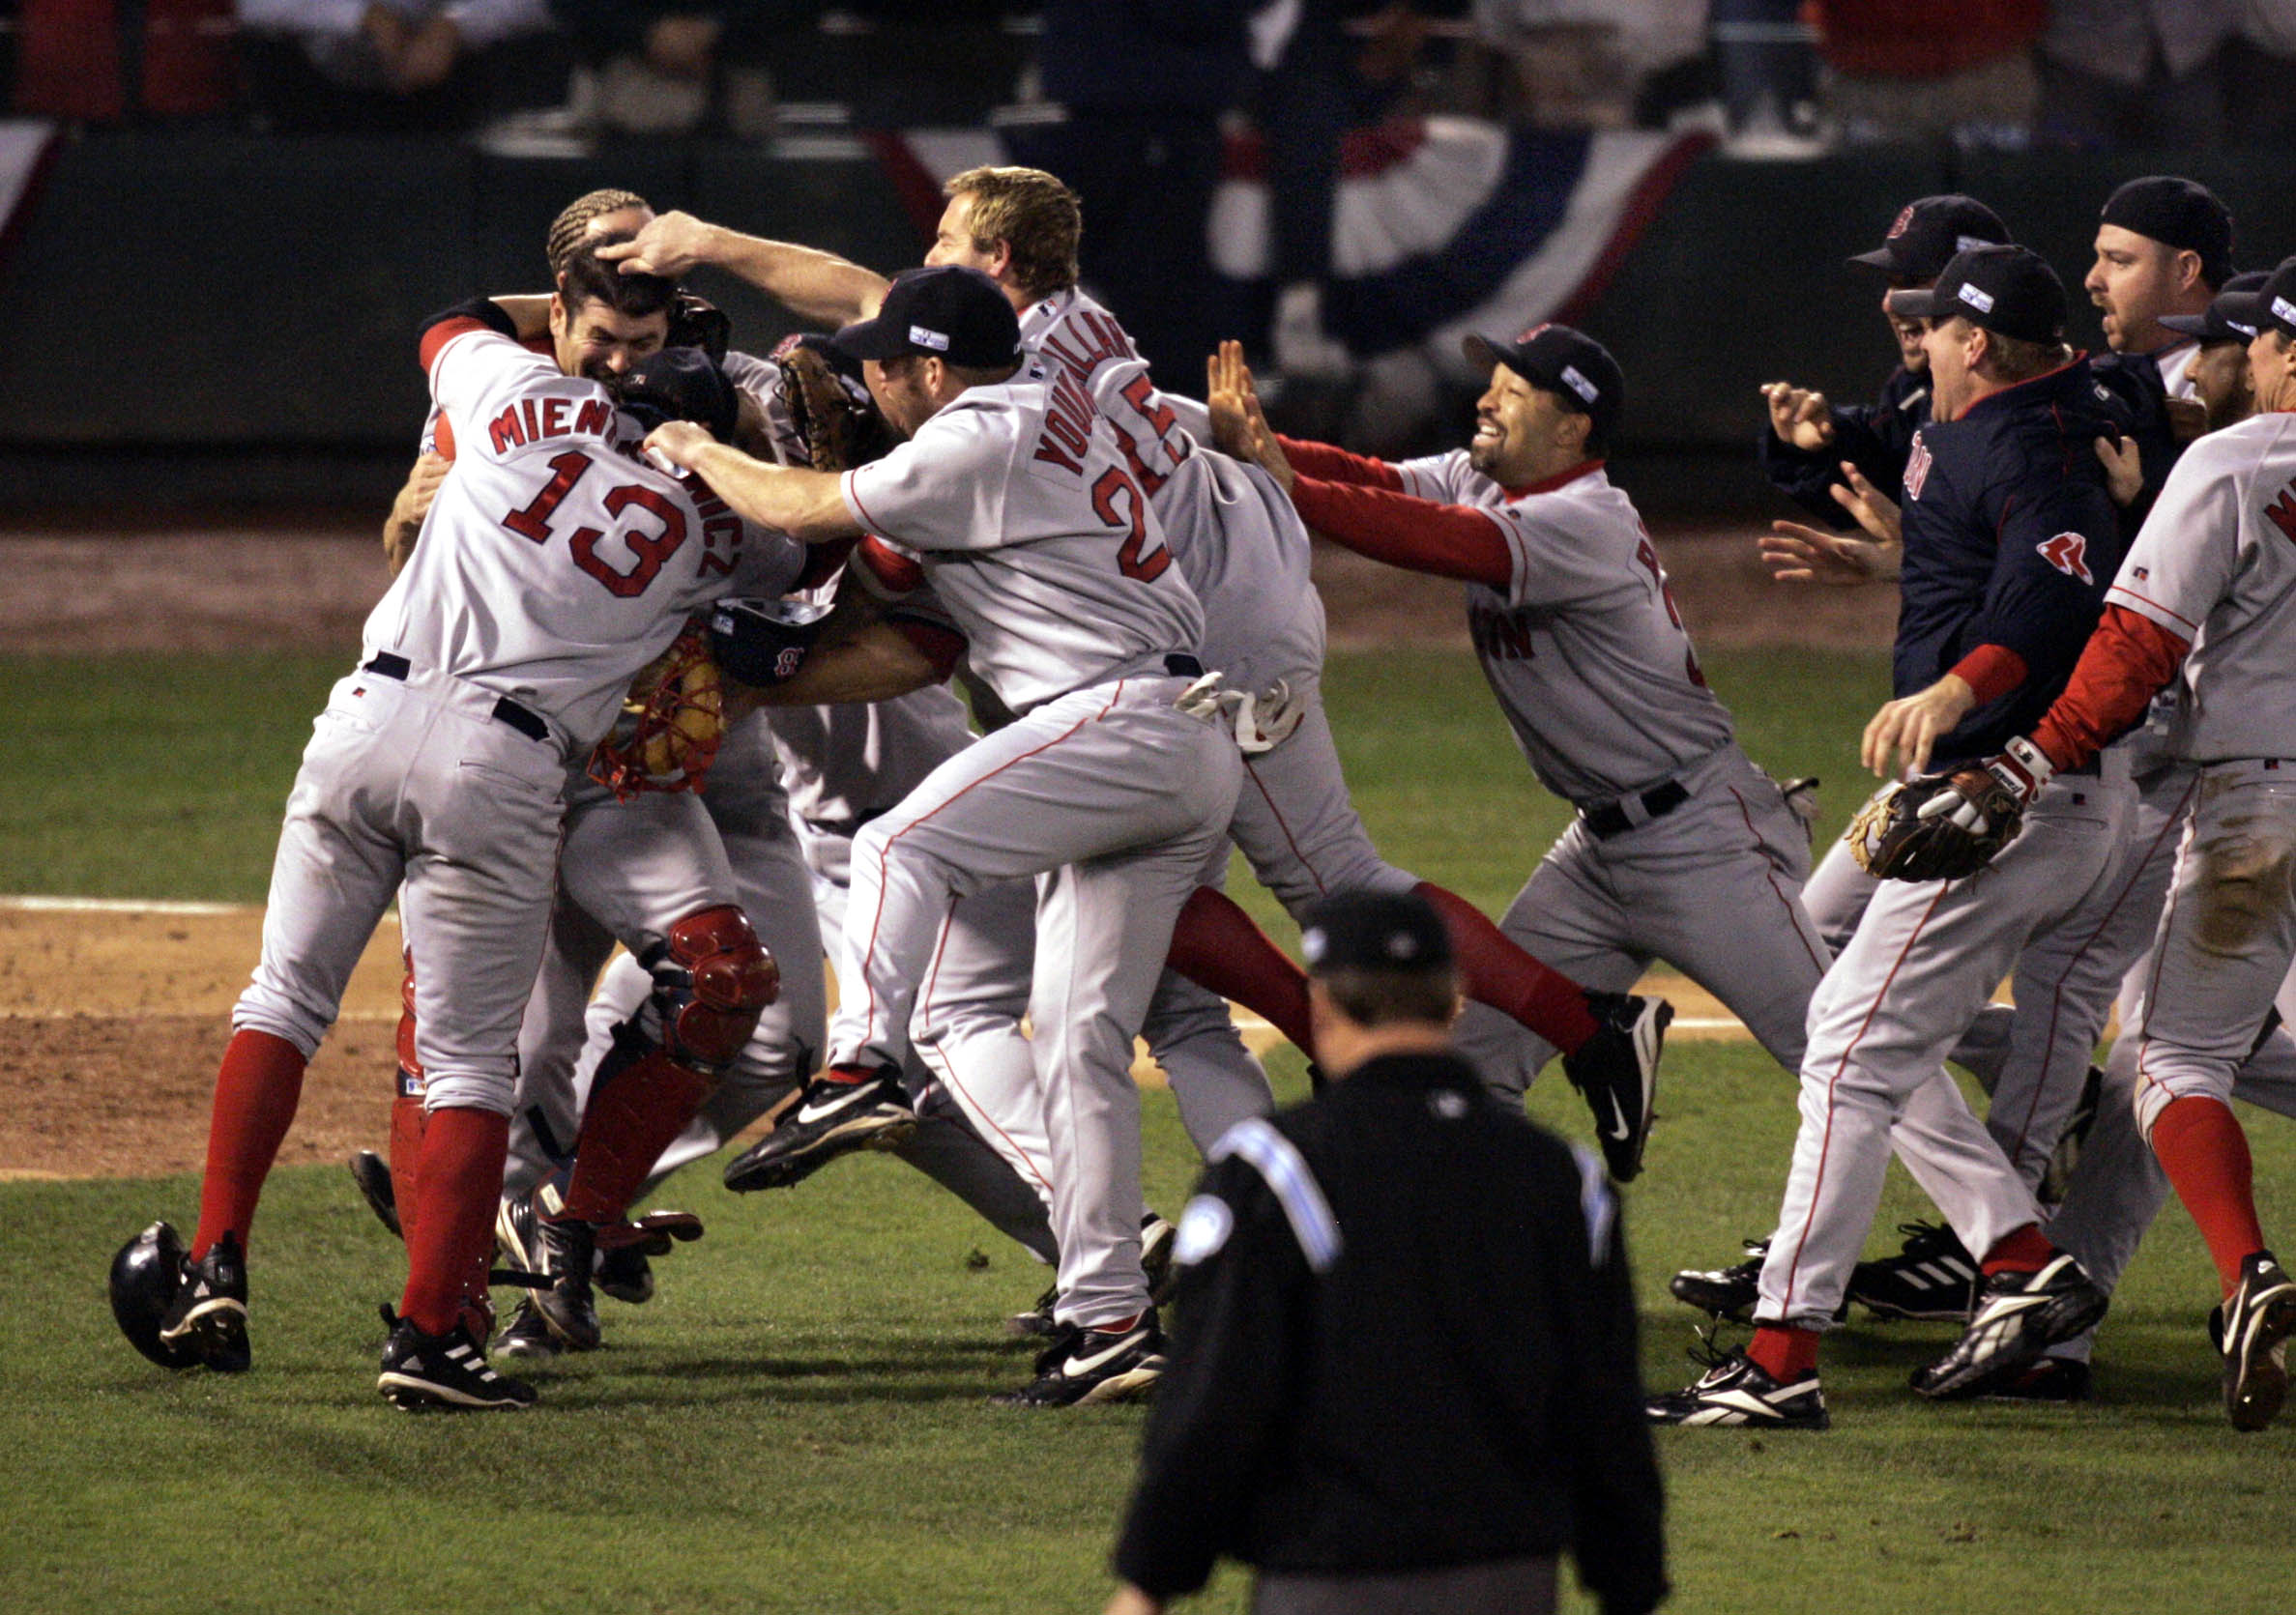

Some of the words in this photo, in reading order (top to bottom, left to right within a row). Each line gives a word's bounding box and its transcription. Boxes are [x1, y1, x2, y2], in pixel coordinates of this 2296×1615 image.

[1040, 310, 1136, 383] ILLAR
[501, 449, 687, 597] 13
[1090, 464, 1173, 584] 2
